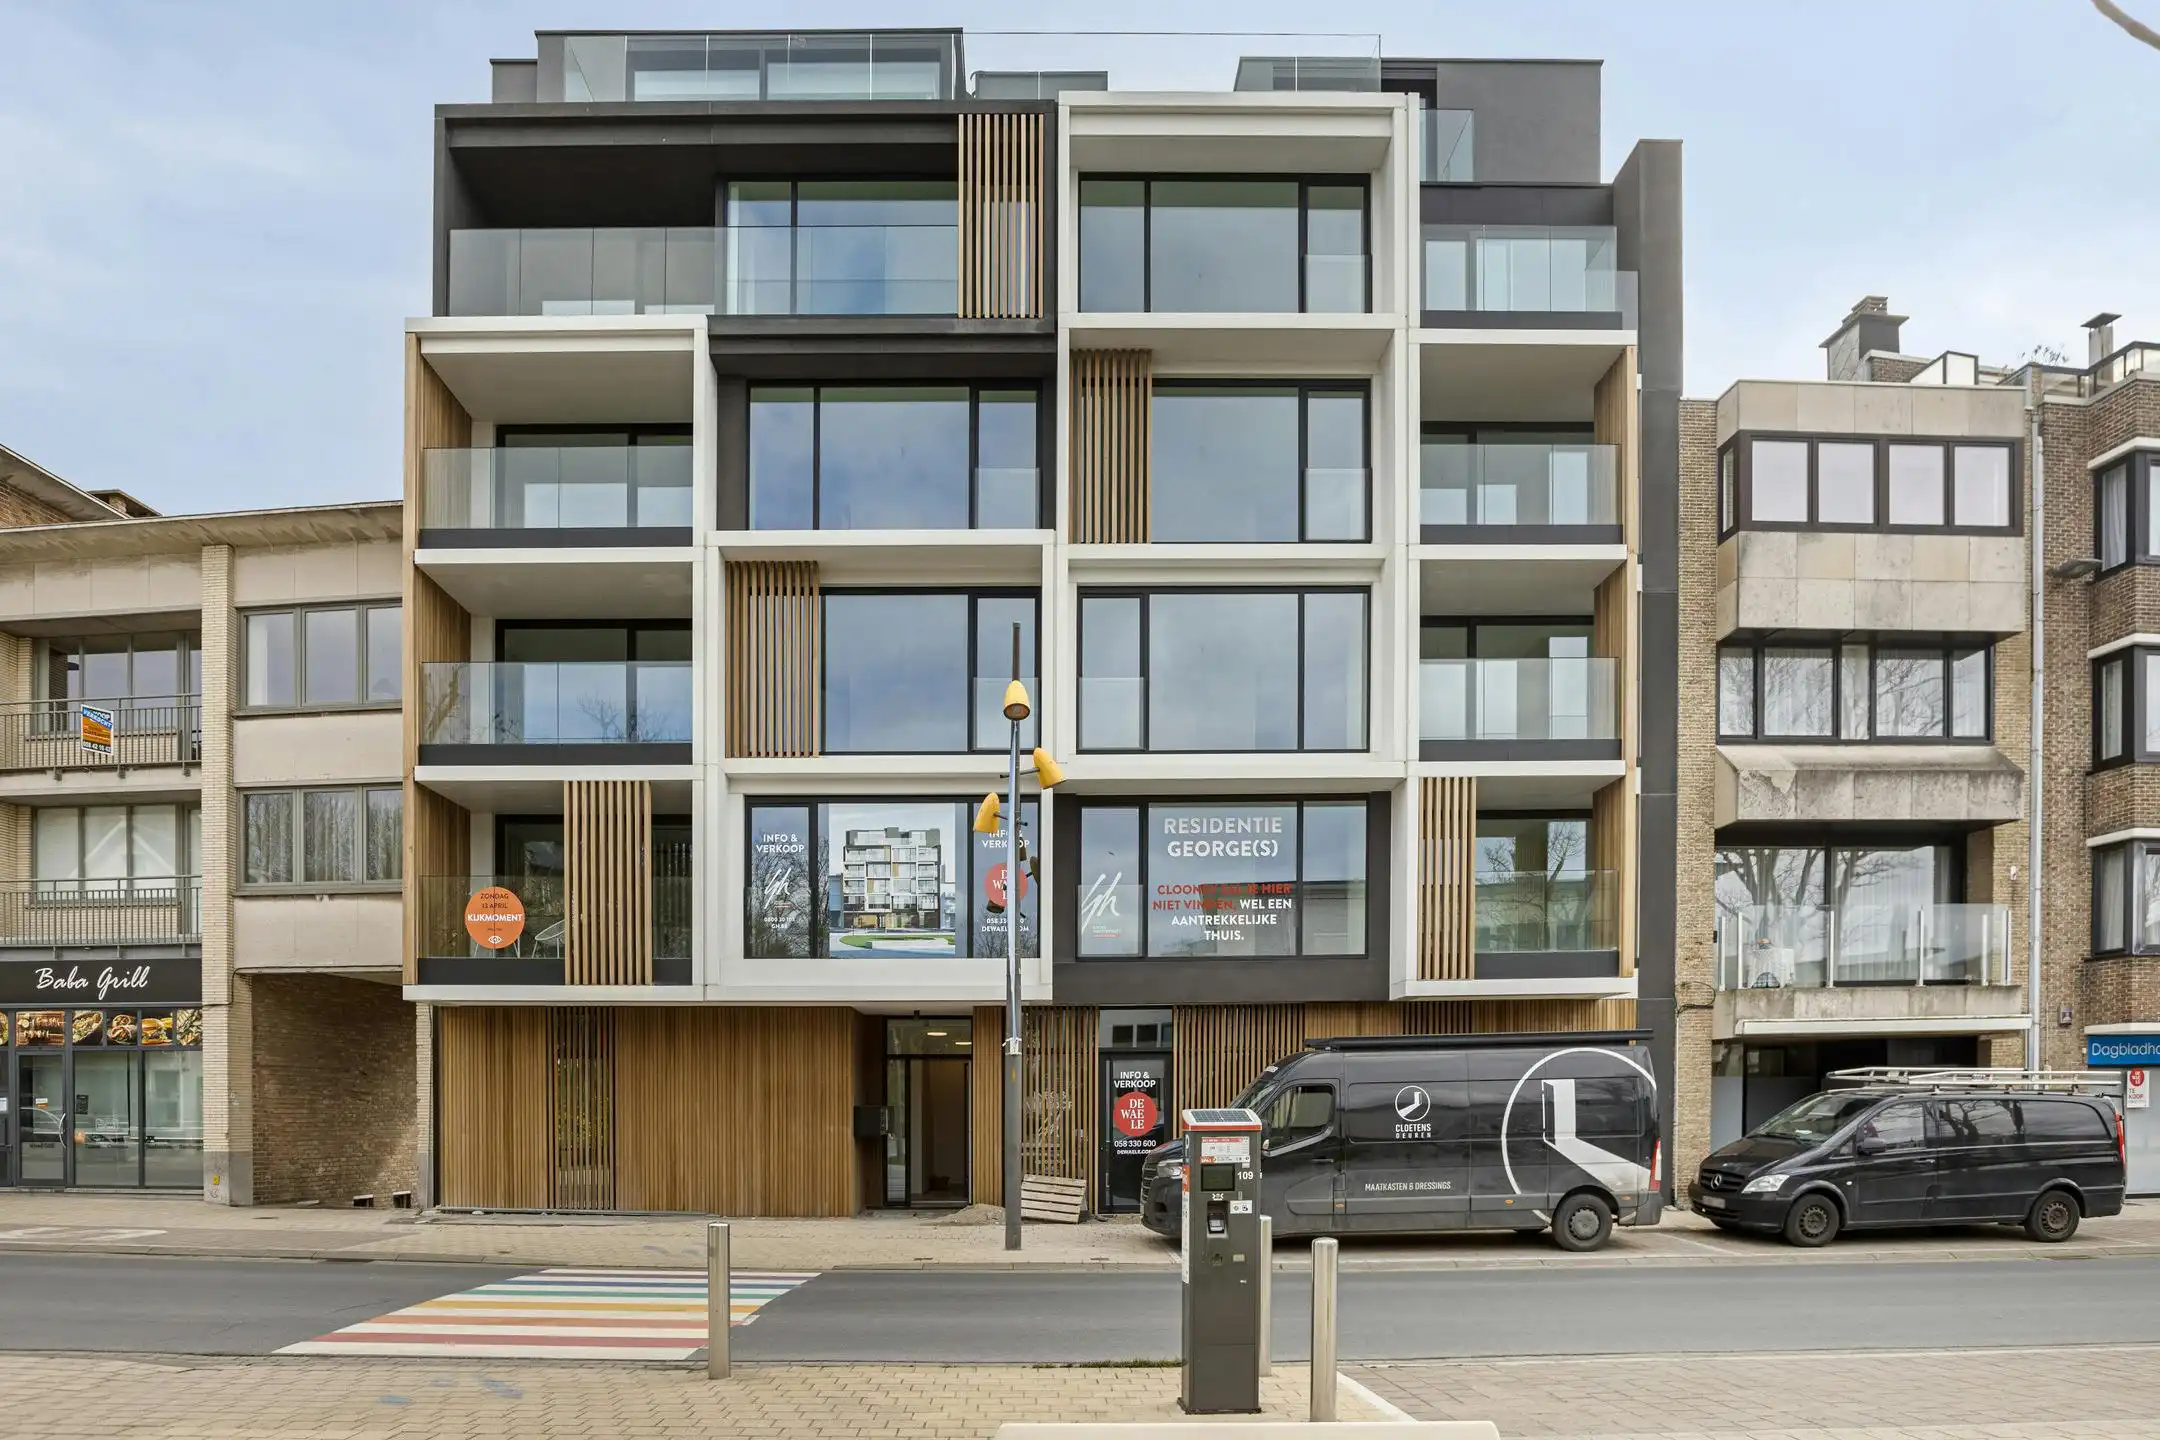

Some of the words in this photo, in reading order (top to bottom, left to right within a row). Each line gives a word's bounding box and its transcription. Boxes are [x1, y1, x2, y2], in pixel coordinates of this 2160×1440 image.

[83, 708, 112, 729] VERKOCHT
[1164, 817, 1282, 834] RESIDENTIE
[763, 834, 788, 843] INFO
[790, 833, 798, 842] &
[756, 844, 805, 853] VERKOOP
[982, 839, 1030, 848] VERKOP
[1167, 839, 1279, 857] GEORGE(S)
[1262, 882, 1292, 894] HIER
[1152, 900, 1181, 911] NIET
[1240, 898, 1266, 909] WEL
[1268, 898, 1292, 909] EEN
[467, 913, 523, 922] KIJKMOMENT
[1171, 914, 1277, 926] AANTREKKELIJKE
[1204, 929, 1245, 941] THUIS.
[35, 965, 89, 989] Baba
[96, 965, 151, 1001] Grill
[1120, 1071, 1141, 1079] INFO
[1143, 1071, 1150, 1079] &
[1113, 1079, 1156, 1089] VERKOOP
[1129, 1098, 1145, 1109] DE
[1120, 1109, 1145, 1119] WAE
[1130, 1119, 1145, 1130] LE
[1395, 1123, 1432, 1132] CLOETENS
[1114, 1140, 1128, 1148] 058
[1128, 1140, 1142, 1148] 330
[1143, 1139, 1157, 1148] 600
[1237, 1171, 1254, 1180] 109
[1365, 1182, 1408, 1191] MAATKASTEN
[1415, 1181, 1451, 1190] DRESSINGS
